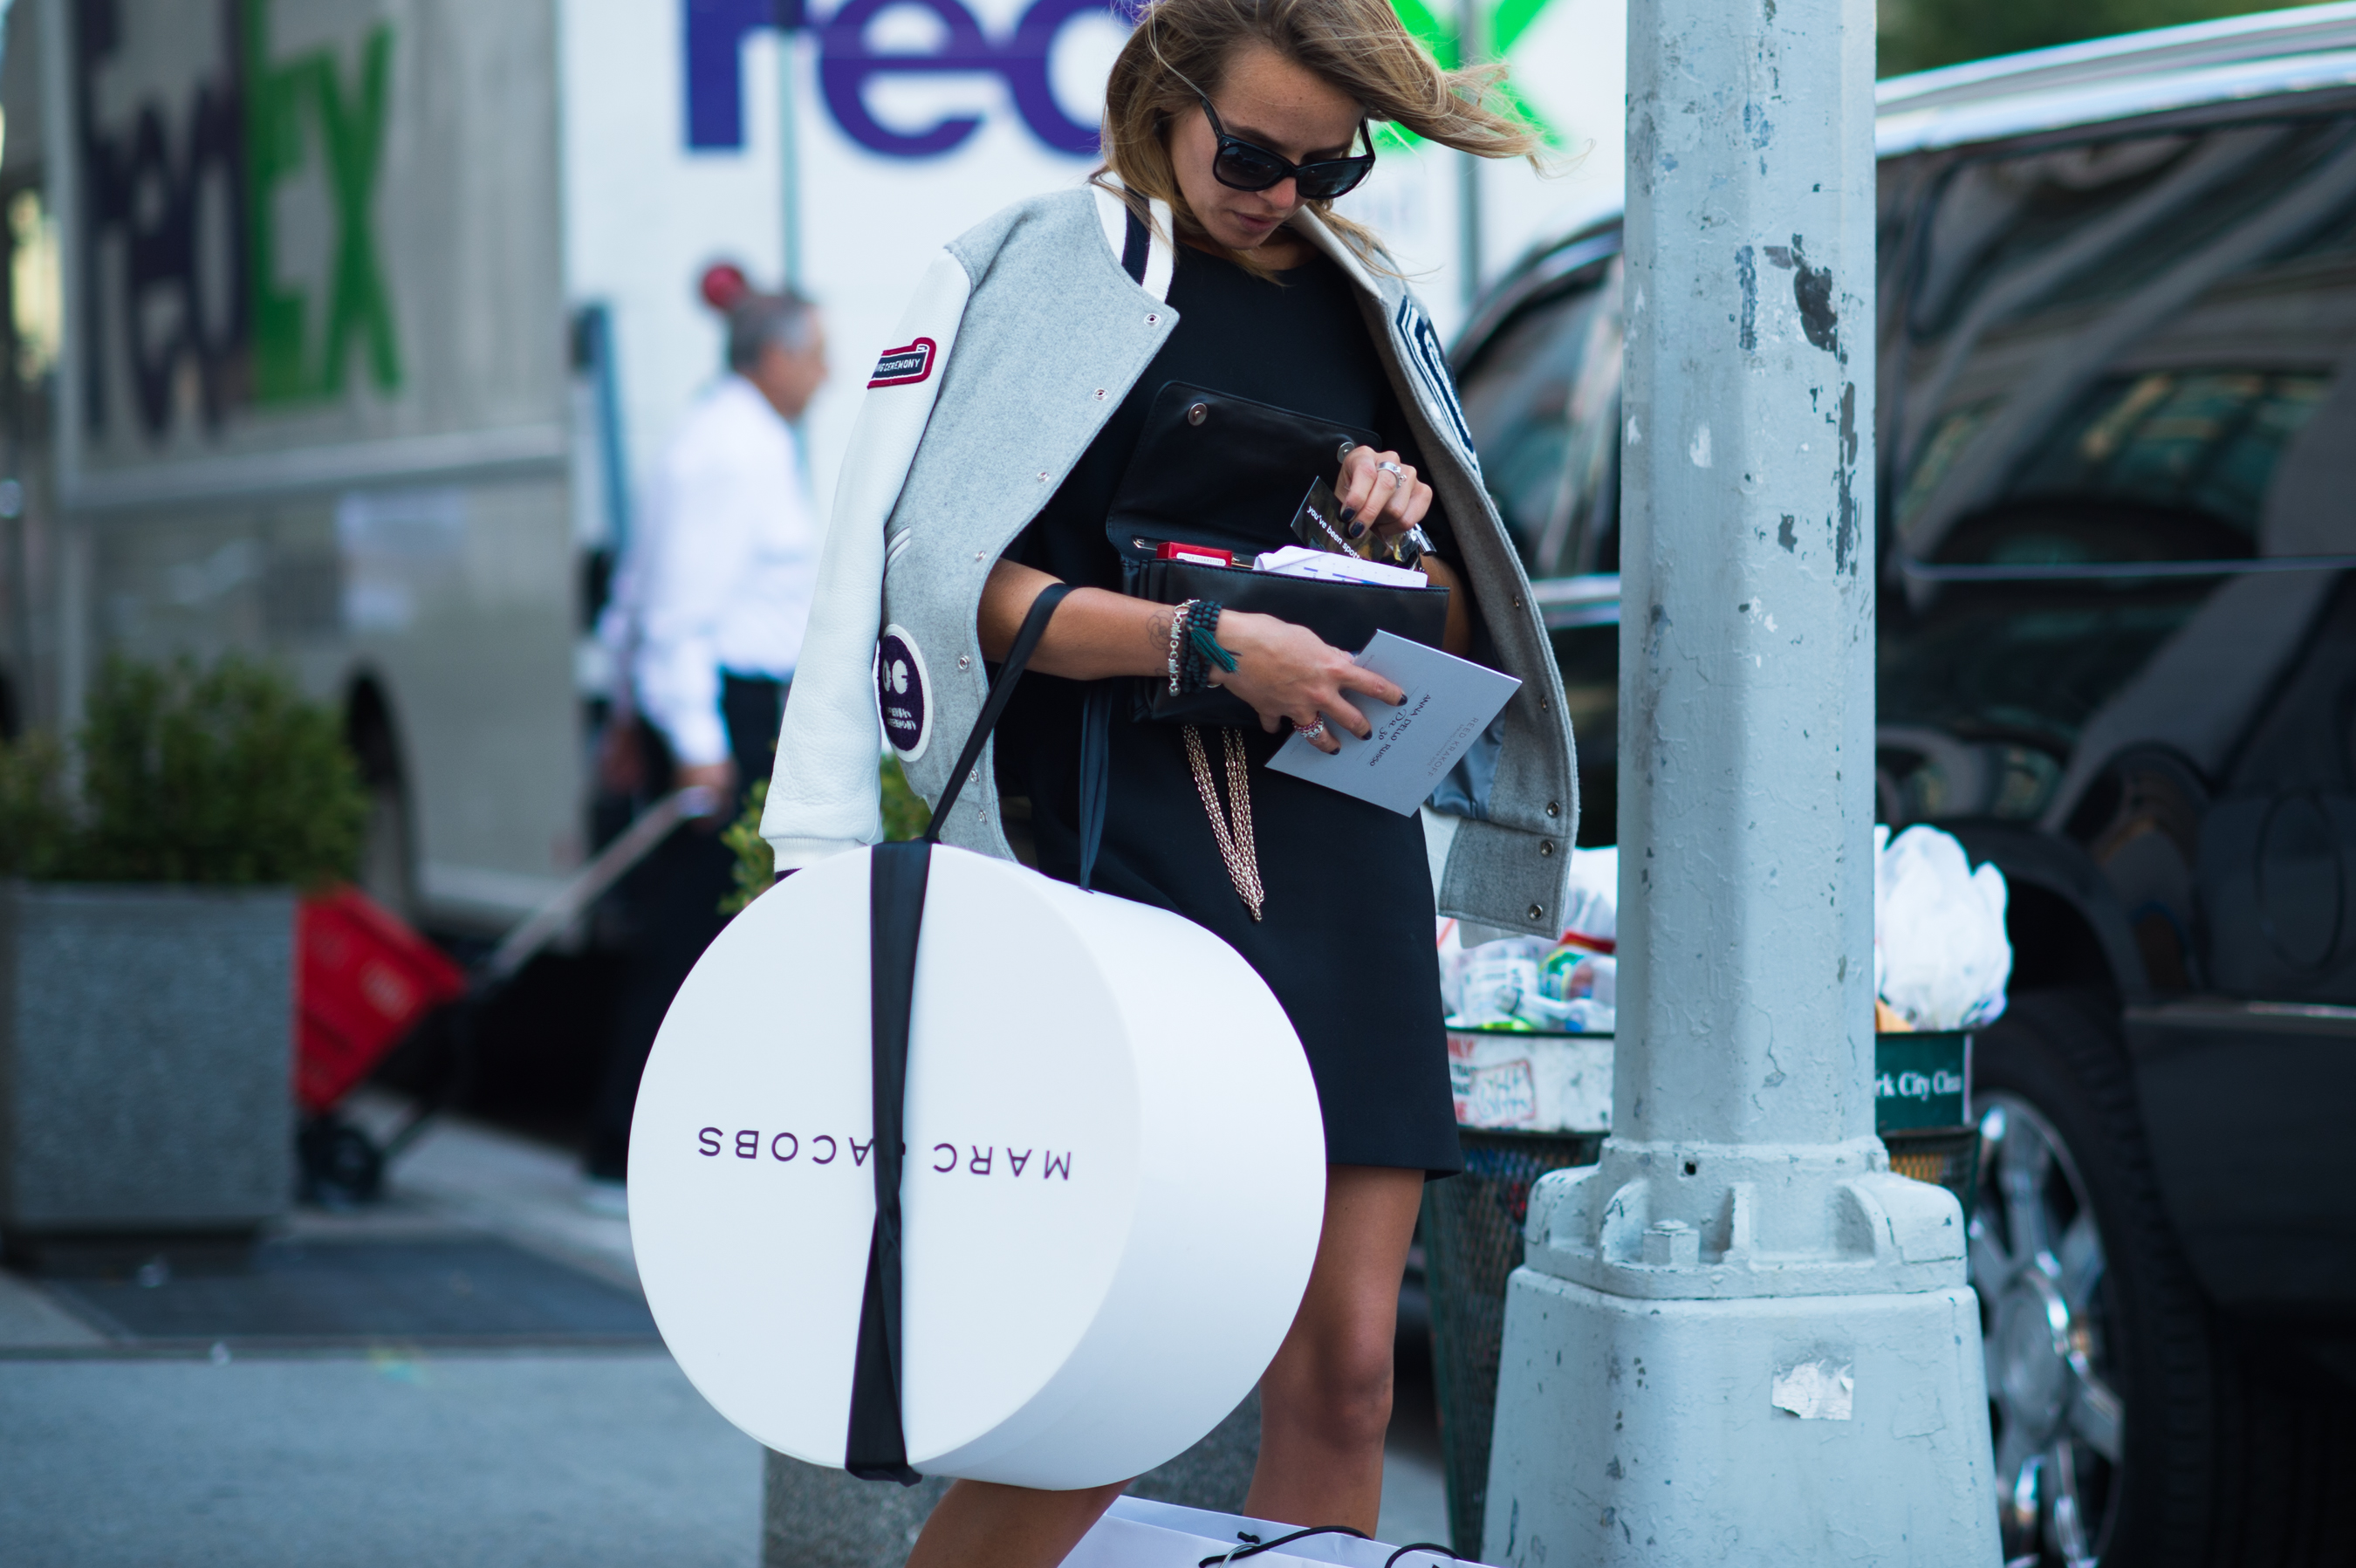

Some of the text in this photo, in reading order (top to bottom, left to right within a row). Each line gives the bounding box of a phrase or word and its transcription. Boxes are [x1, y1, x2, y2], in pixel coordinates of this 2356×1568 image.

[1307, 505, 1362, 560] you've been spott
[1370, 695, 1431, 766] ANNA DELLO RUSSO
[1428, 717, 1479, 777] REED KRAKOFF
[1875, 1072, 1895, 1097] rk
[1899, 1072, 1930, 1101] City
[698, 1127, 1071, 1181] MARC ACOBS
